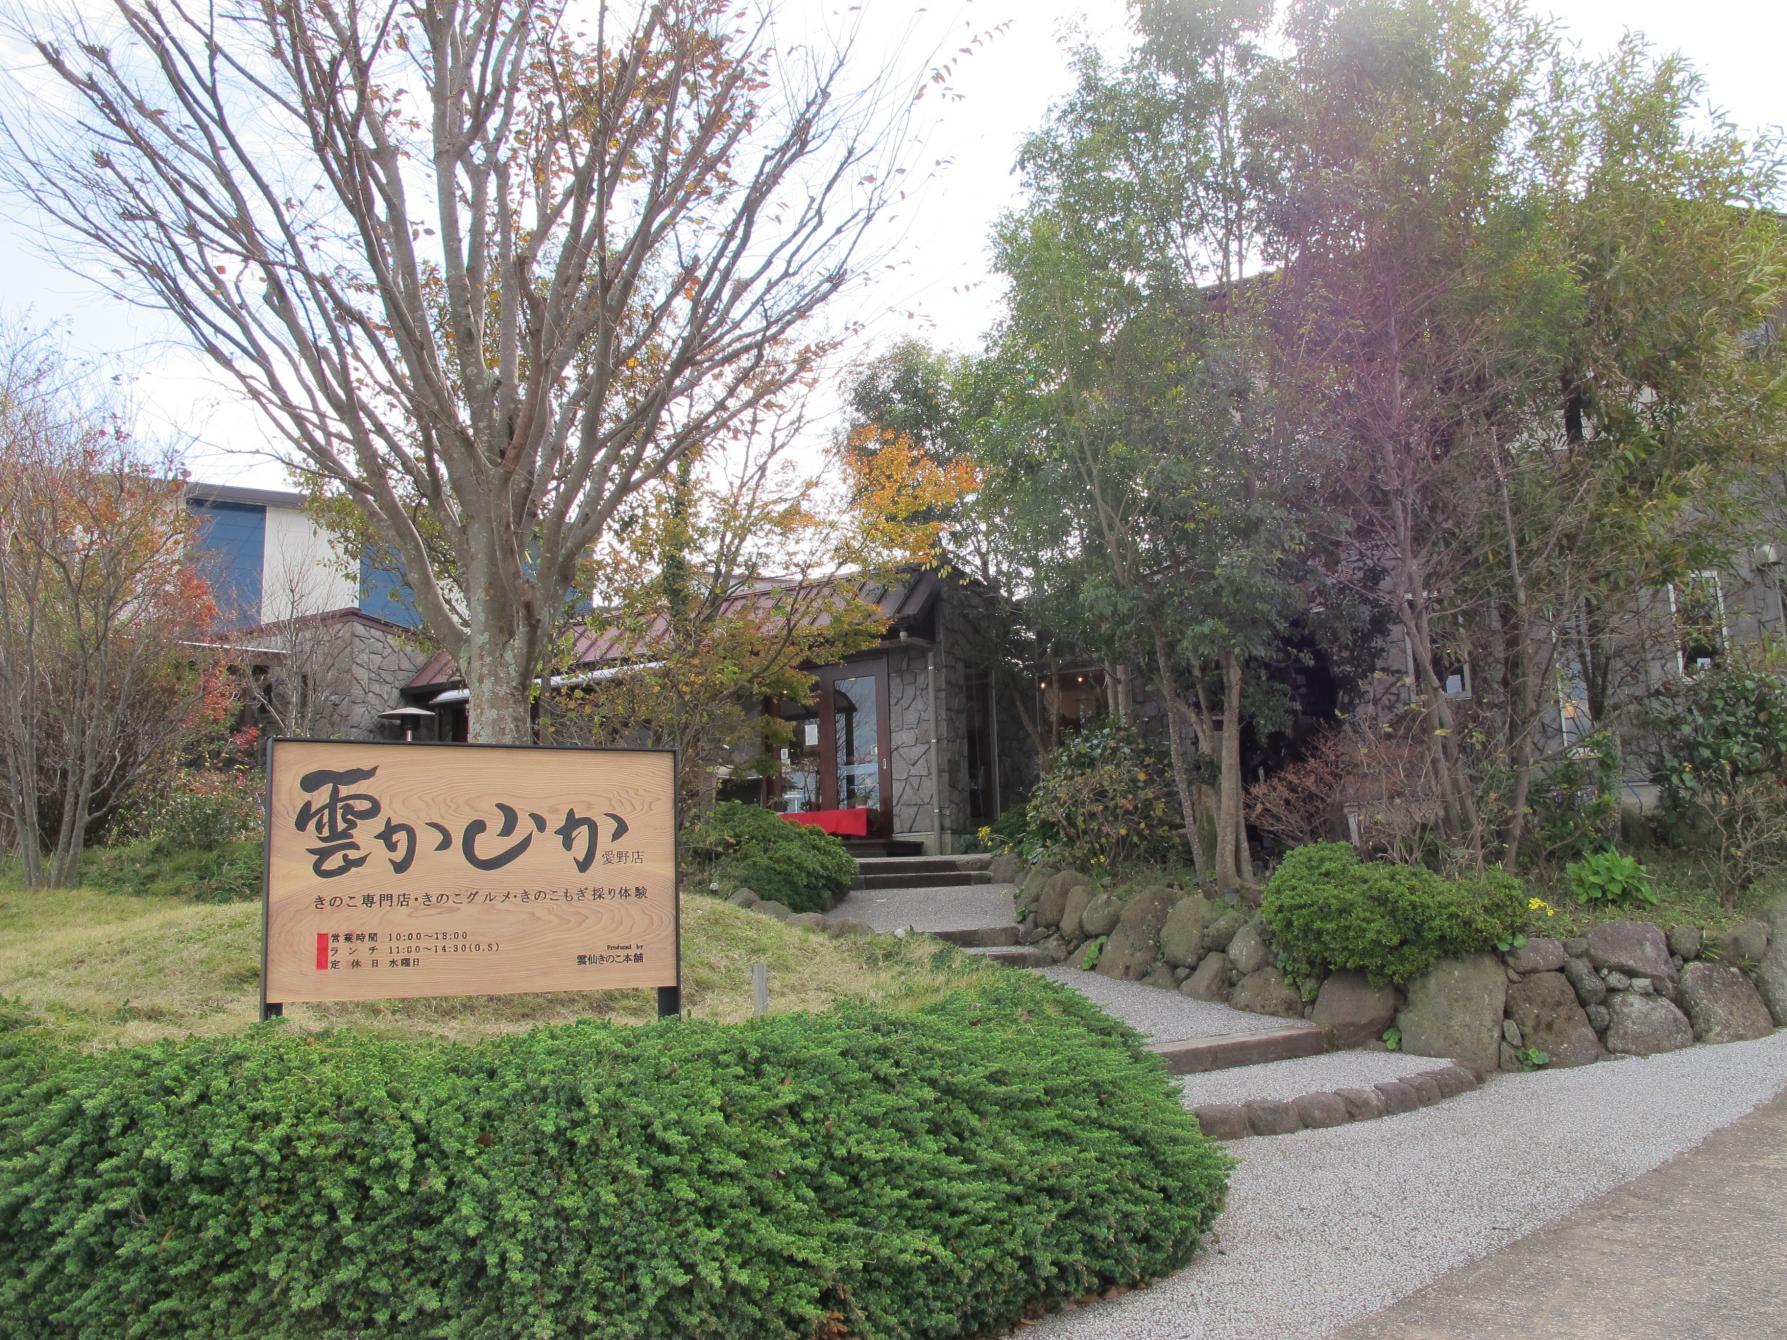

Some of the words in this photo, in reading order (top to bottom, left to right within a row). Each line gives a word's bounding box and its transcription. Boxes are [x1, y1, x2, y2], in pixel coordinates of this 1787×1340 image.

[601, 850, 644, 866] 愛野店
[331, 933, 378, 943] 営業時間
[388, 958, 420, 968] 水曜日
